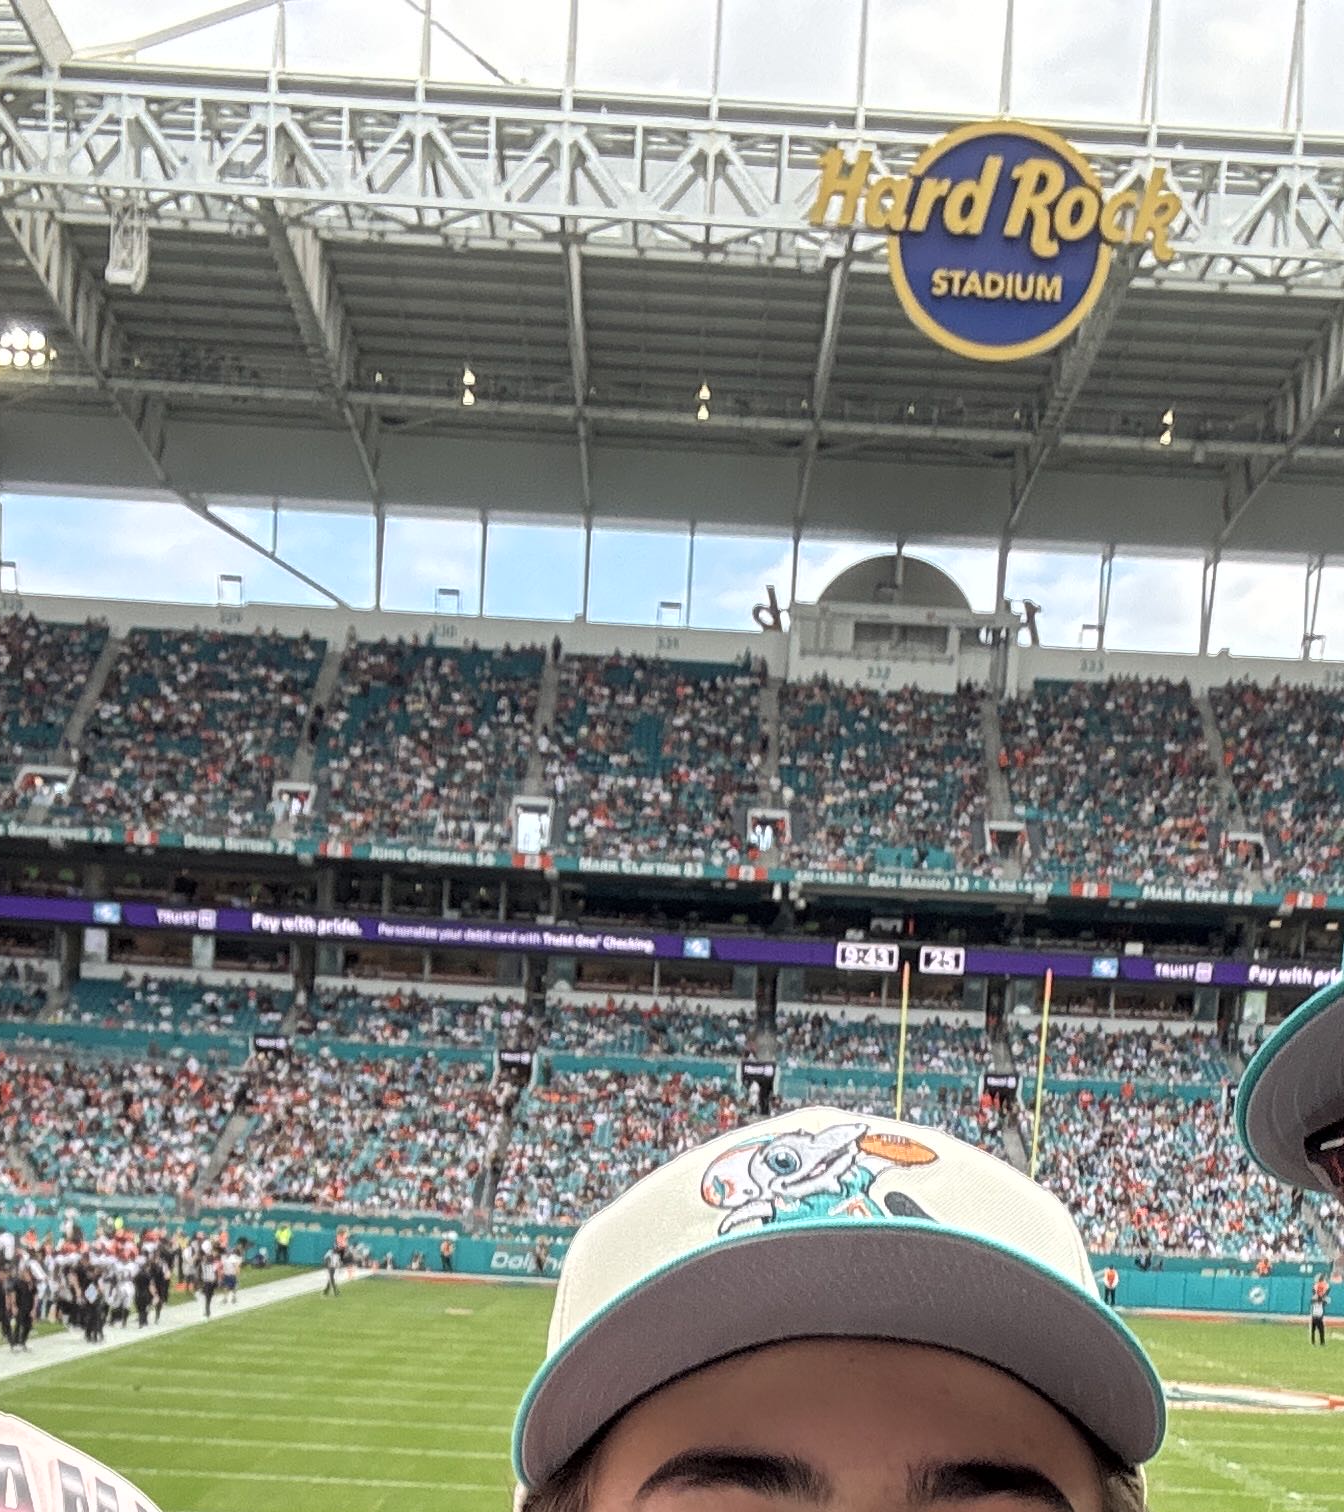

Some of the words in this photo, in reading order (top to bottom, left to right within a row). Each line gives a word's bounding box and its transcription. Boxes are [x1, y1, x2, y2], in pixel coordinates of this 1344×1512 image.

[809, 147, 1004, 236] Hard
[1004, 158, 1182, 262] Rock
[931, 267, 1063, 303] STADIUM
[251, 912, 280, 934] Pay
[281, 914, 317, 934] with
[844, 947, 890, 966] 9:43
[929, 950, 956, 971] 25
[1248, 964, 1278, 986] Pay
[1278, 966, 1313, 986] with
